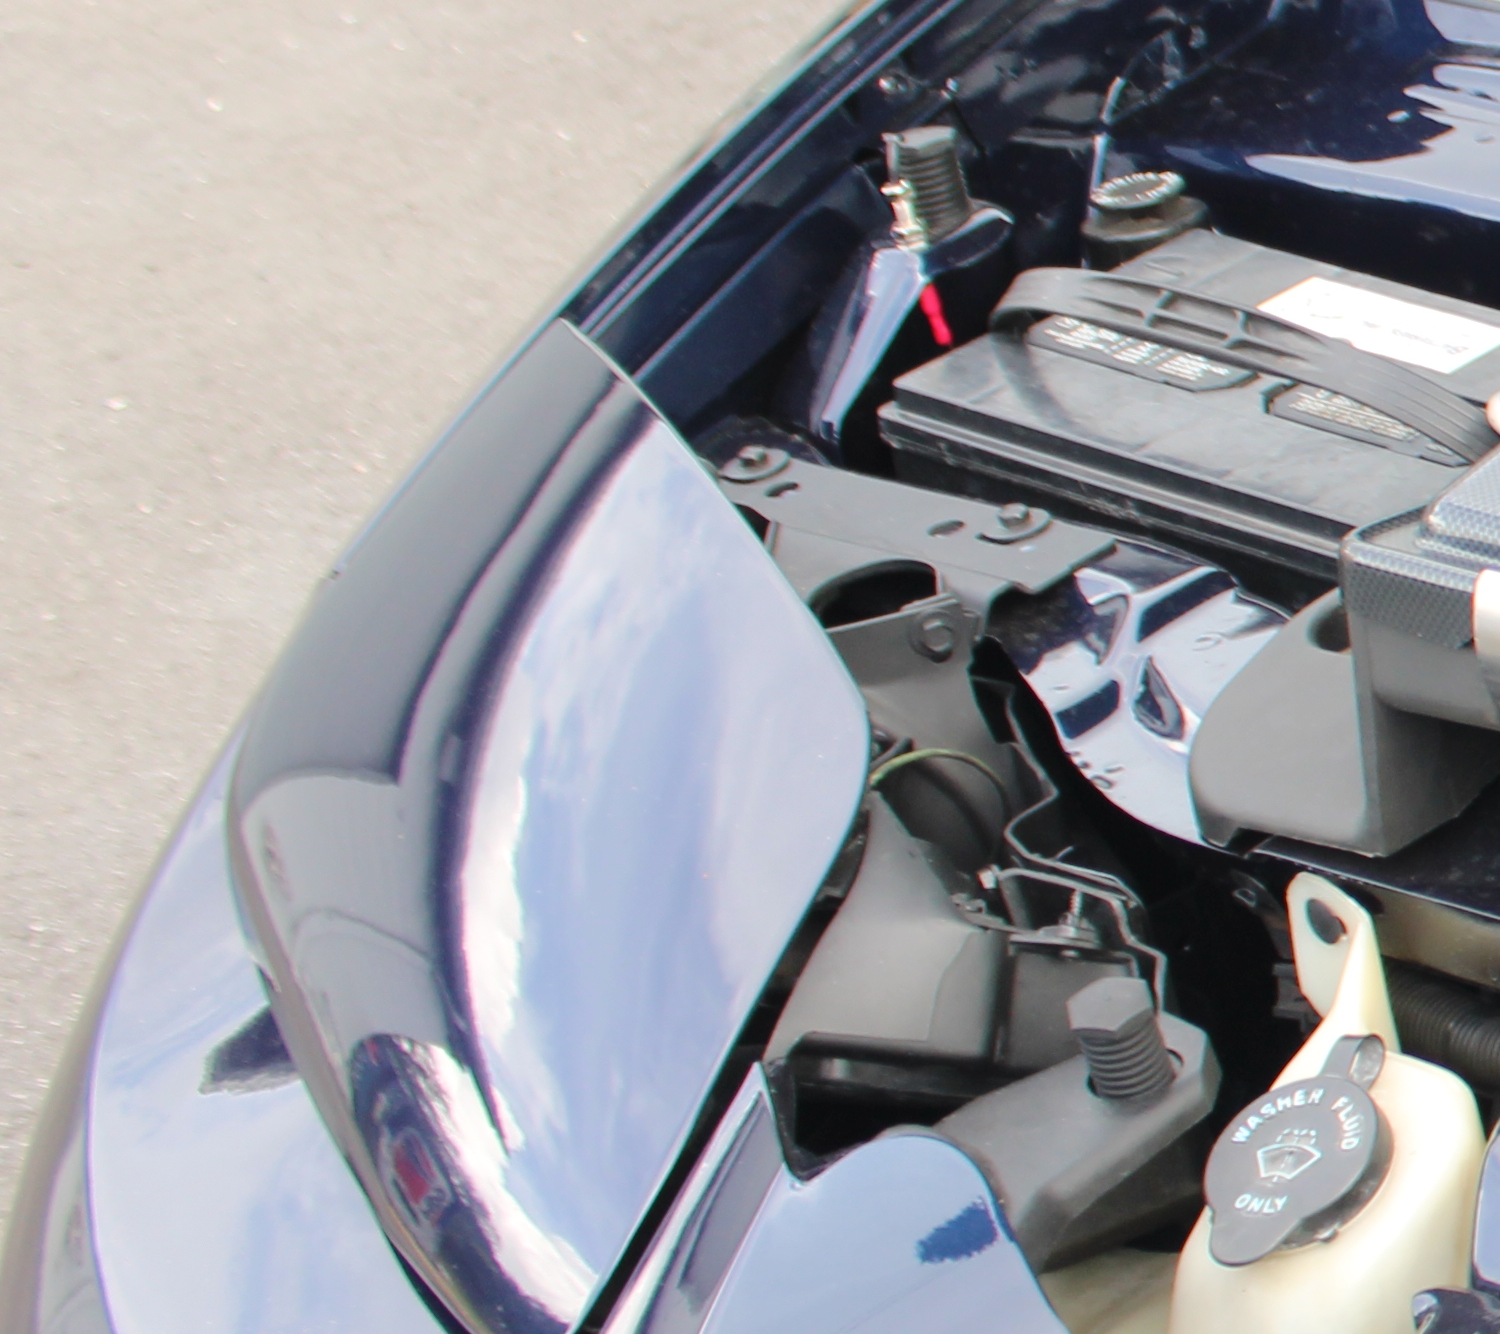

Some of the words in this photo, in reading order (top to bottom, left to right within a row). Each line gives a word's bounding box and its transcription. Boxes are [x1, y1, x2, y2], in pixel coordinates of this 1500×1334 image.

[1230, 1086, 1324, 1145] WASHER
[1331, 1096, 1360, 1152] FLUID
[1233, 1192, 1288, 1213] ONLY
